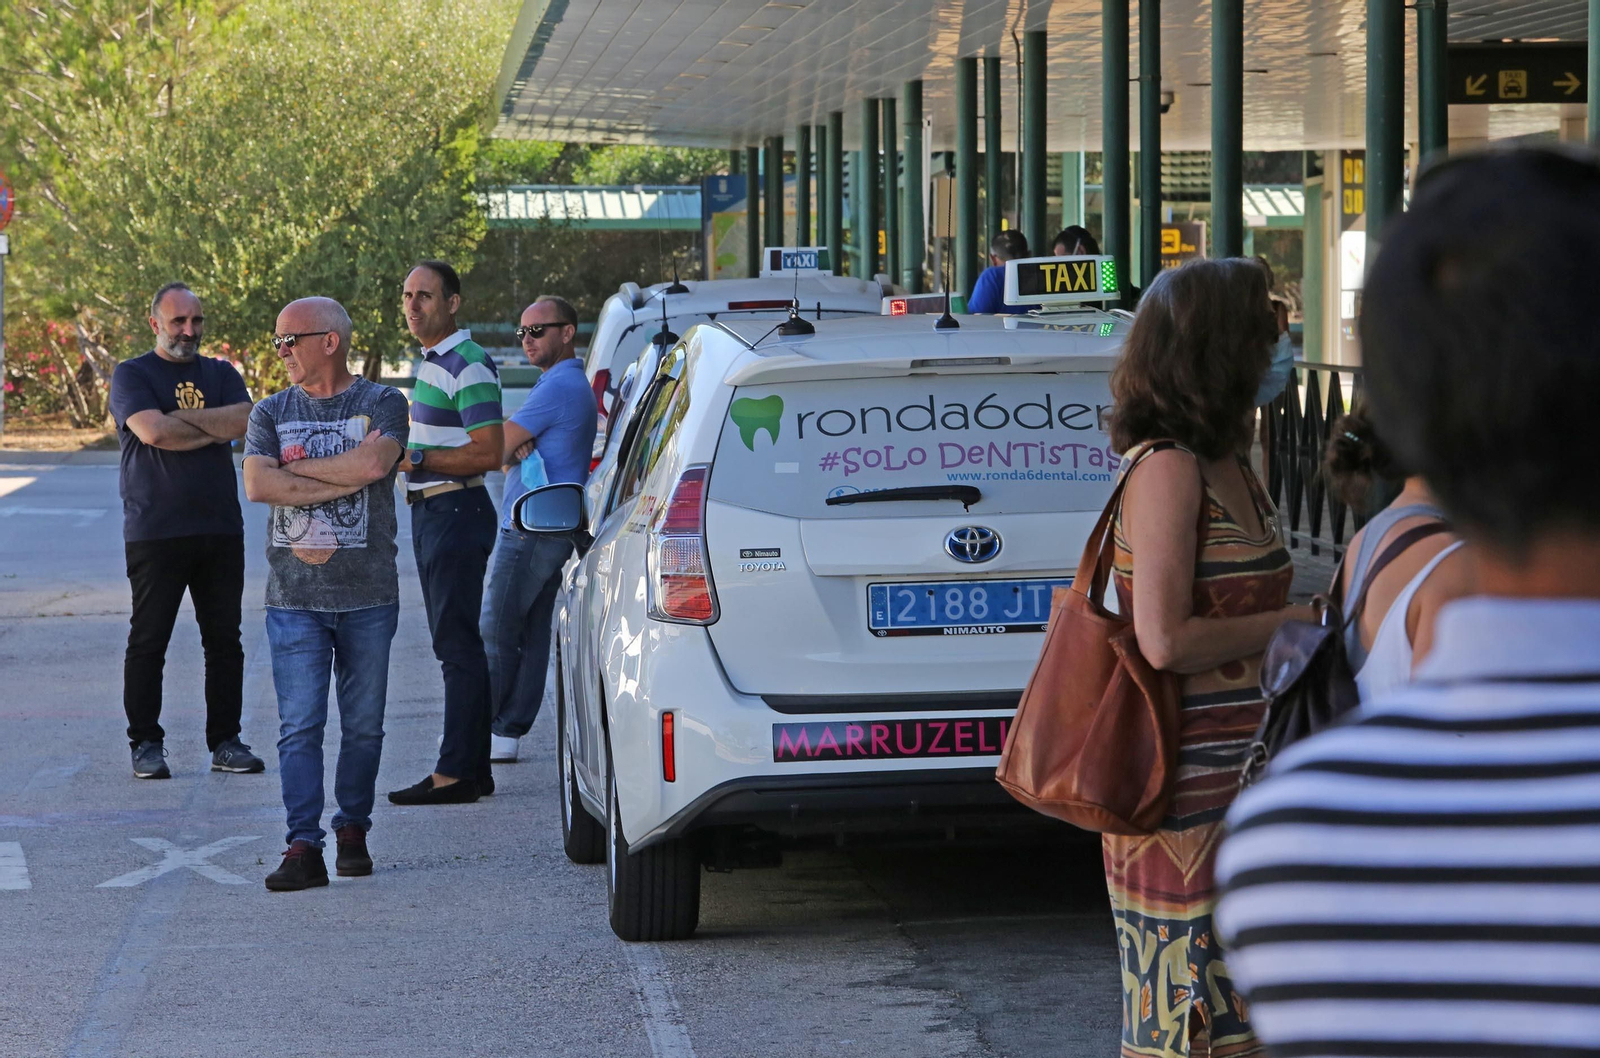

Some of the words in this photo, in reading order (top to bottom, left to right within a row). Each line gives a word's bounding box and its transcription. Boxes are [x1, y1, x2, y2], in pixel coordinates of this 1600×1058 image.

[785, 253, 815, 268] TAXI
[1040, 261, 1096, 293] TAXI
[947, 470, 1111, 482] www.ronda6dental.com
[738, 561, 787, 573] TOYOTA
[876, 611, 884, 621] E
[897, 586, 989, 622] 2188
[1003, 583, 1070, 619] JT
[943, 625, 1006, 636] NIMAUTO
